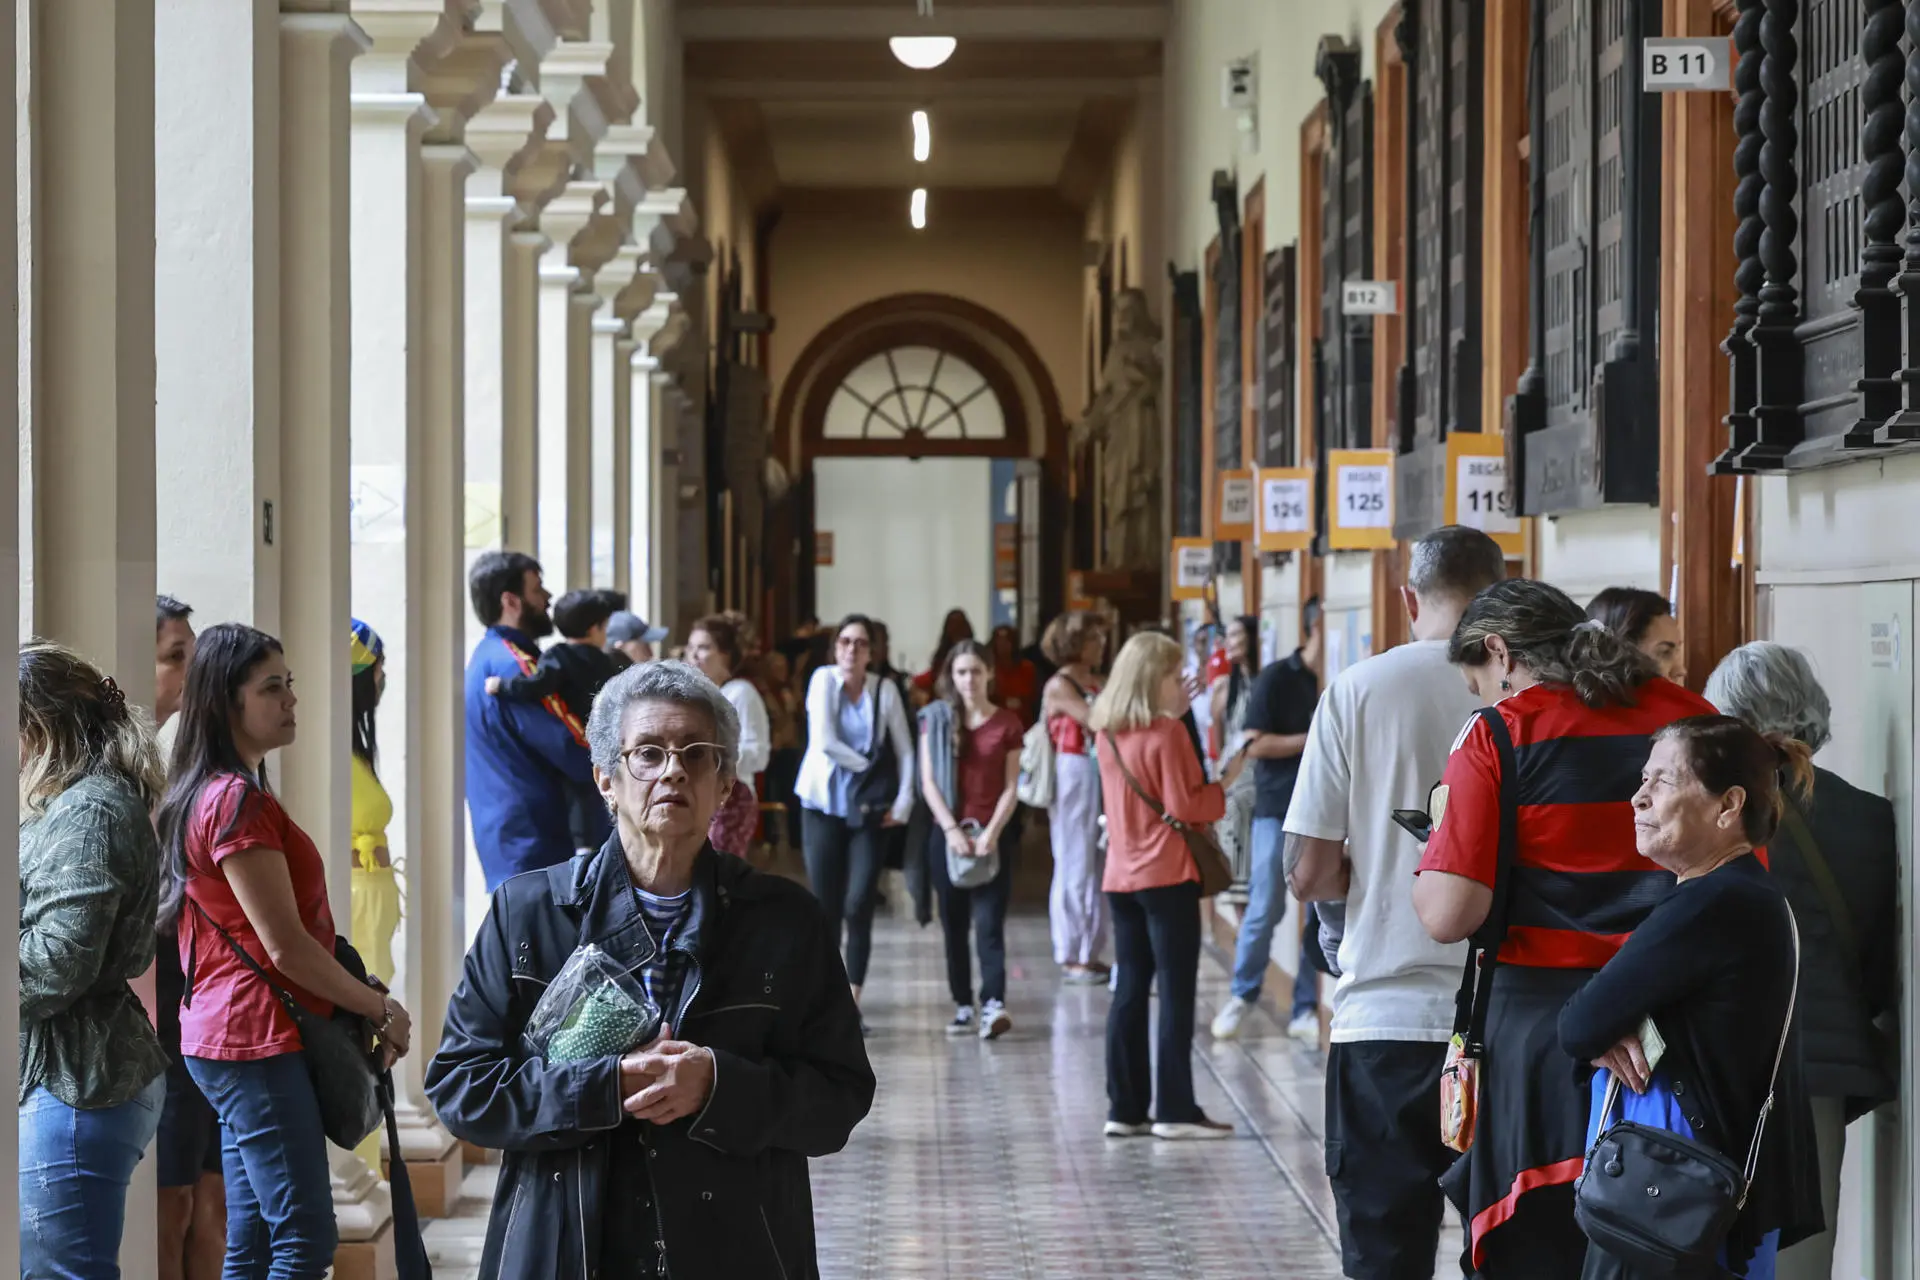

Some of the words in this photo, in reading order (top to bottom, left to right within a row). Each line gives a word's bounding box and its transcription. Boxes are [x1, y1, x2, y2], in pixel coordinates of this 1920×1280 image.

[1652, 54, 1668, 75] B
[1679, 53, 1705, 75] 11
[1348, 290, 1377, 305] B12
[1272, 501, 1304, 518] 126
[1346, 493, 1385, 511] 125
